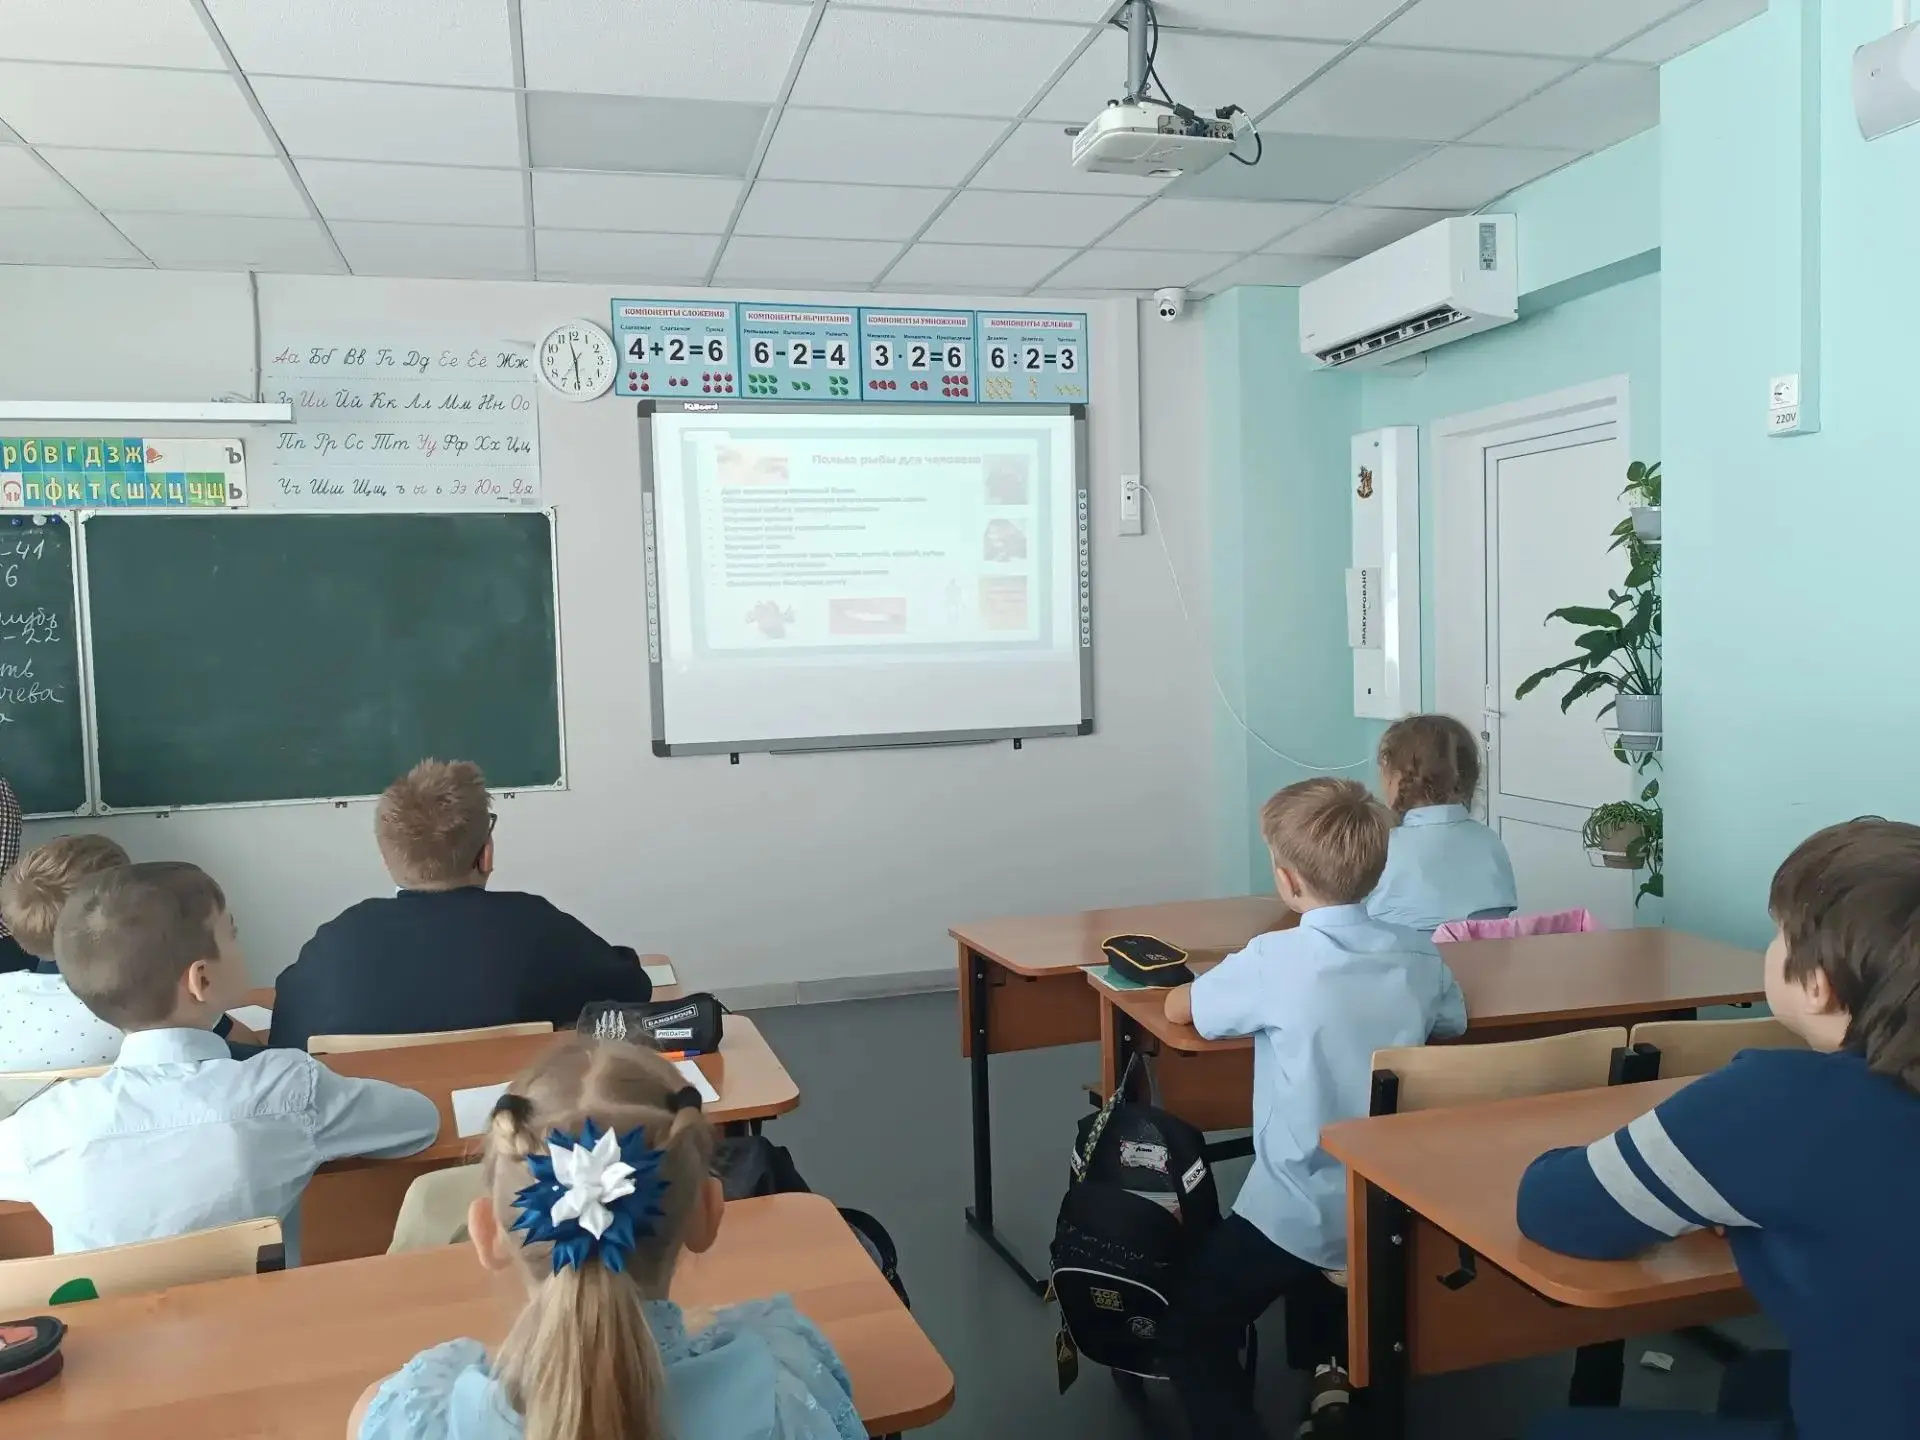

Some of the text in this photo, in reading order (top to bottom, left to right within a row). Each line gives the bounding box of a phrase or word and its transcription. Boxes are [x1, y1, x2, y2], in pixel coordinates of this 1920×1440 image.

[624, 308, 725, 318] КОМПОНЕНТЫ СЛОЖЕНИЯ
[558, 334, 565, 344] 11
[569, 331, 579, 341] 12
[548, 343, 559, 353] 10
[592, 343, 600, 353] 2
[272, 347, 529, 374] Аа Бб Вв Гг Дд Ее Ёё Жж
[547, 356, 554, 366] 9
[597, 355, 604, 365] 3
[551, 368, 558, 378] 8
[561, 377, 568, 387] 7
[586, 377, 593, 387] 5
[301, 390, 328, 408] Ии
[335, 389, 363, 408] Йй
[369, 392, 398, 409] Кк
[404, 392, 432, 409] Лл
[437, 393, 472, 409] Мм
[478, 394, 506, 410] Нн
[511, 394, 531, 410] Оо
[1776, 412, 1797, 425] 220V
[276, 432, 531, 458] Пп Рр Сс Тт Уу Фф Хх Цц
[278, 477, 534, 497] Чч Шш Щщ ъ ы ь Ээ Юю Яя
